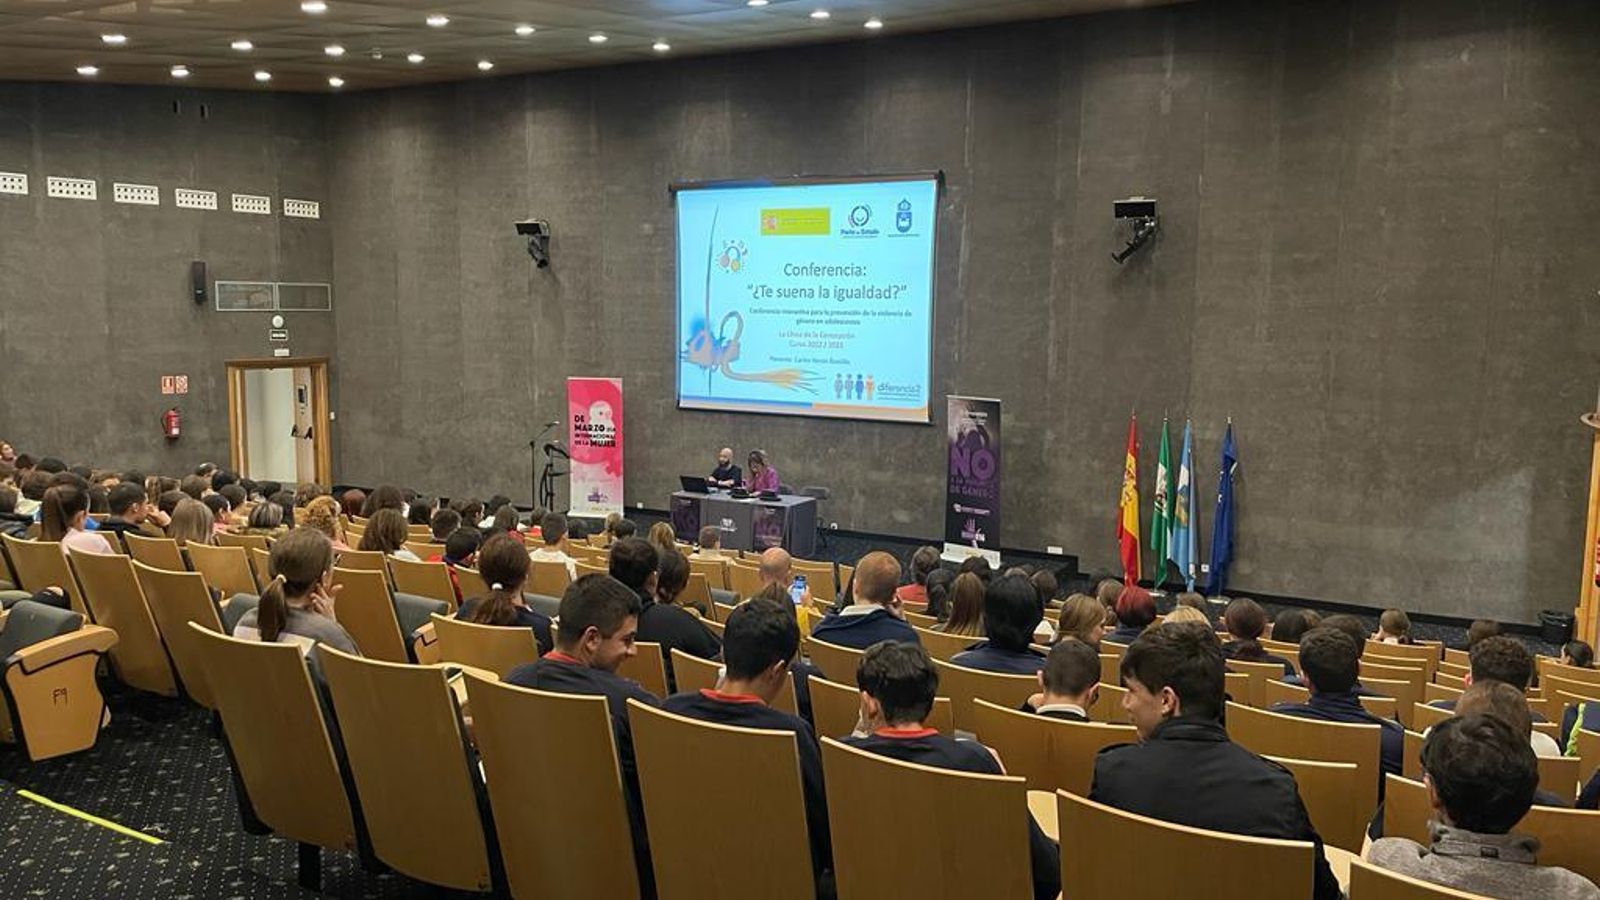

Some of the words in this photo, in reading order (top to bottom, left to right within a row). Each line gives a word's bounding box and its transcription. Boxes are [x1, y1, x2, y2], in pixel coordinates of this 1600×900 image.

[783, 262, 867, 277] Conferencia:
[776, 286, 815, 299] suena
[818, 285, 830, 299] la
[574, 415, 585, 423] DE
[574, 424, 605, 432] MARZO
[590, 439, 616, 448] MUJER
[951, 447, 996, 480] NO
